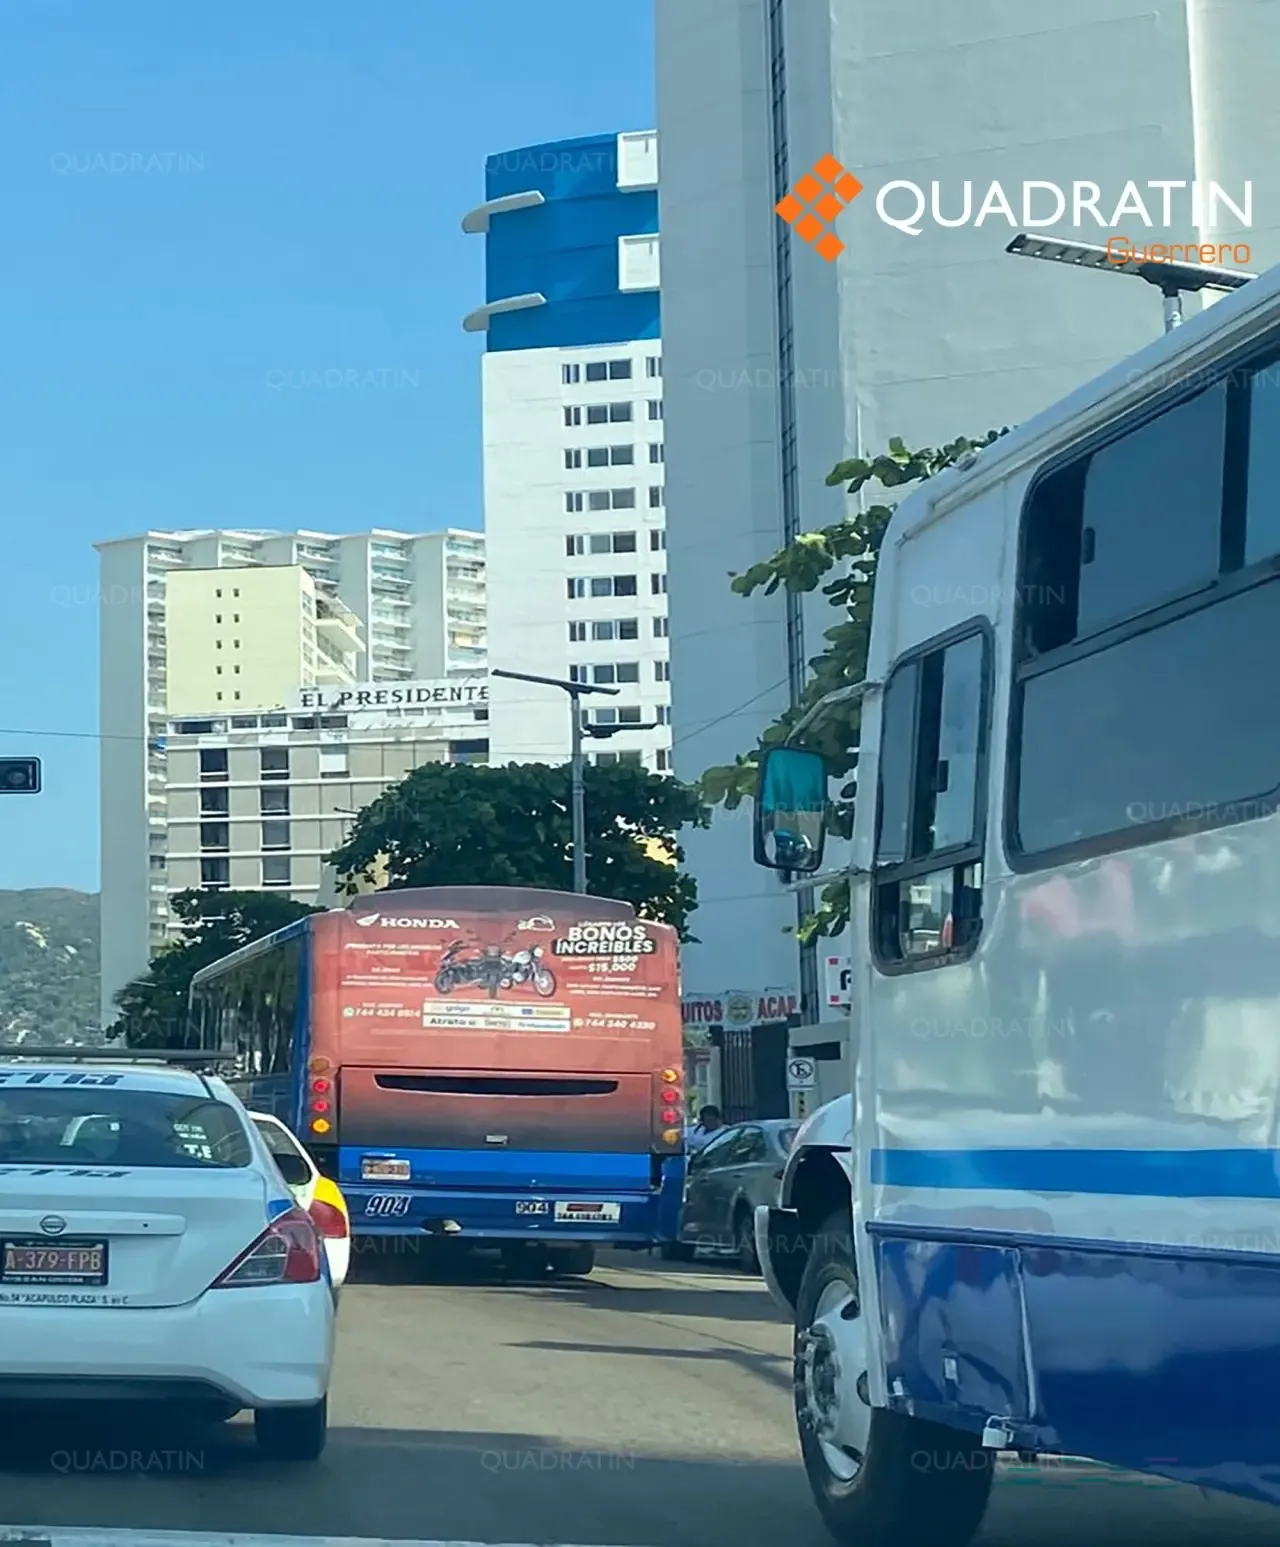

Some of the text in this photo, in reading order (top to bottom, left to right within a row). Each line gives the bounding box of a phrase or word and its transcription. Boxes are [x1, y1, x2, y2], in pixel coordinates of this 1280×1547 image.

[301, 686, 488, 707] EL PRESIDENTE
[380, 917, 460, 929] HONDA
[569, 926, 647, 941] BONOS
[365, 1193, 412, 1217] 904
